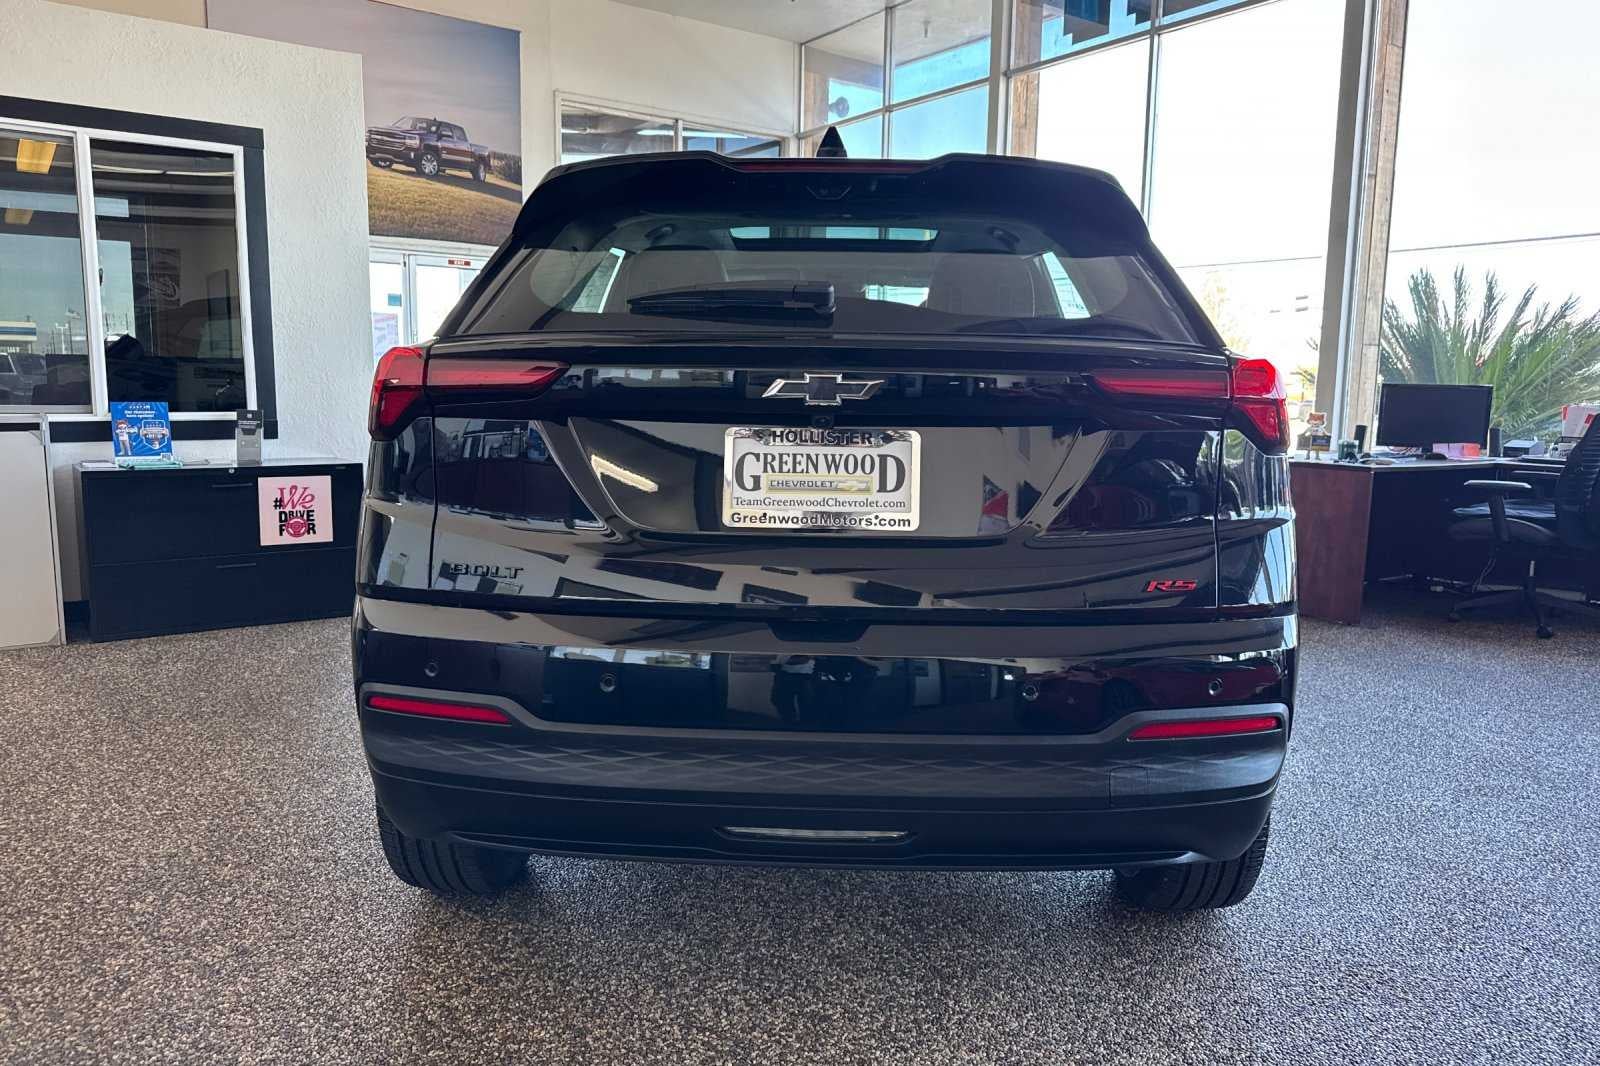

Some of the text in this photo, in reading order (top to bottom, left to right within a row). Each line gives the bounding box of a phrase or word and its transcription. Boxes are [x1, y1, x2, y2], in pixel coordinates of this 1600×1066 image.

[772, 429, 873, 445] HOLLISTER
[735, 451, 906, 493] GREENWOOD
[769, 479, 835, 489] CHEVROLET
[733, 497, 906, 508] TeamGreenwoodChevrolet.com
[279, 510, 315, 523] DRIVE
[731, 512, 911, 527] GreenwoodMotors.com
[450, 563, 524, 579] BOLT
[1146, 579, 1197, 592] RS
